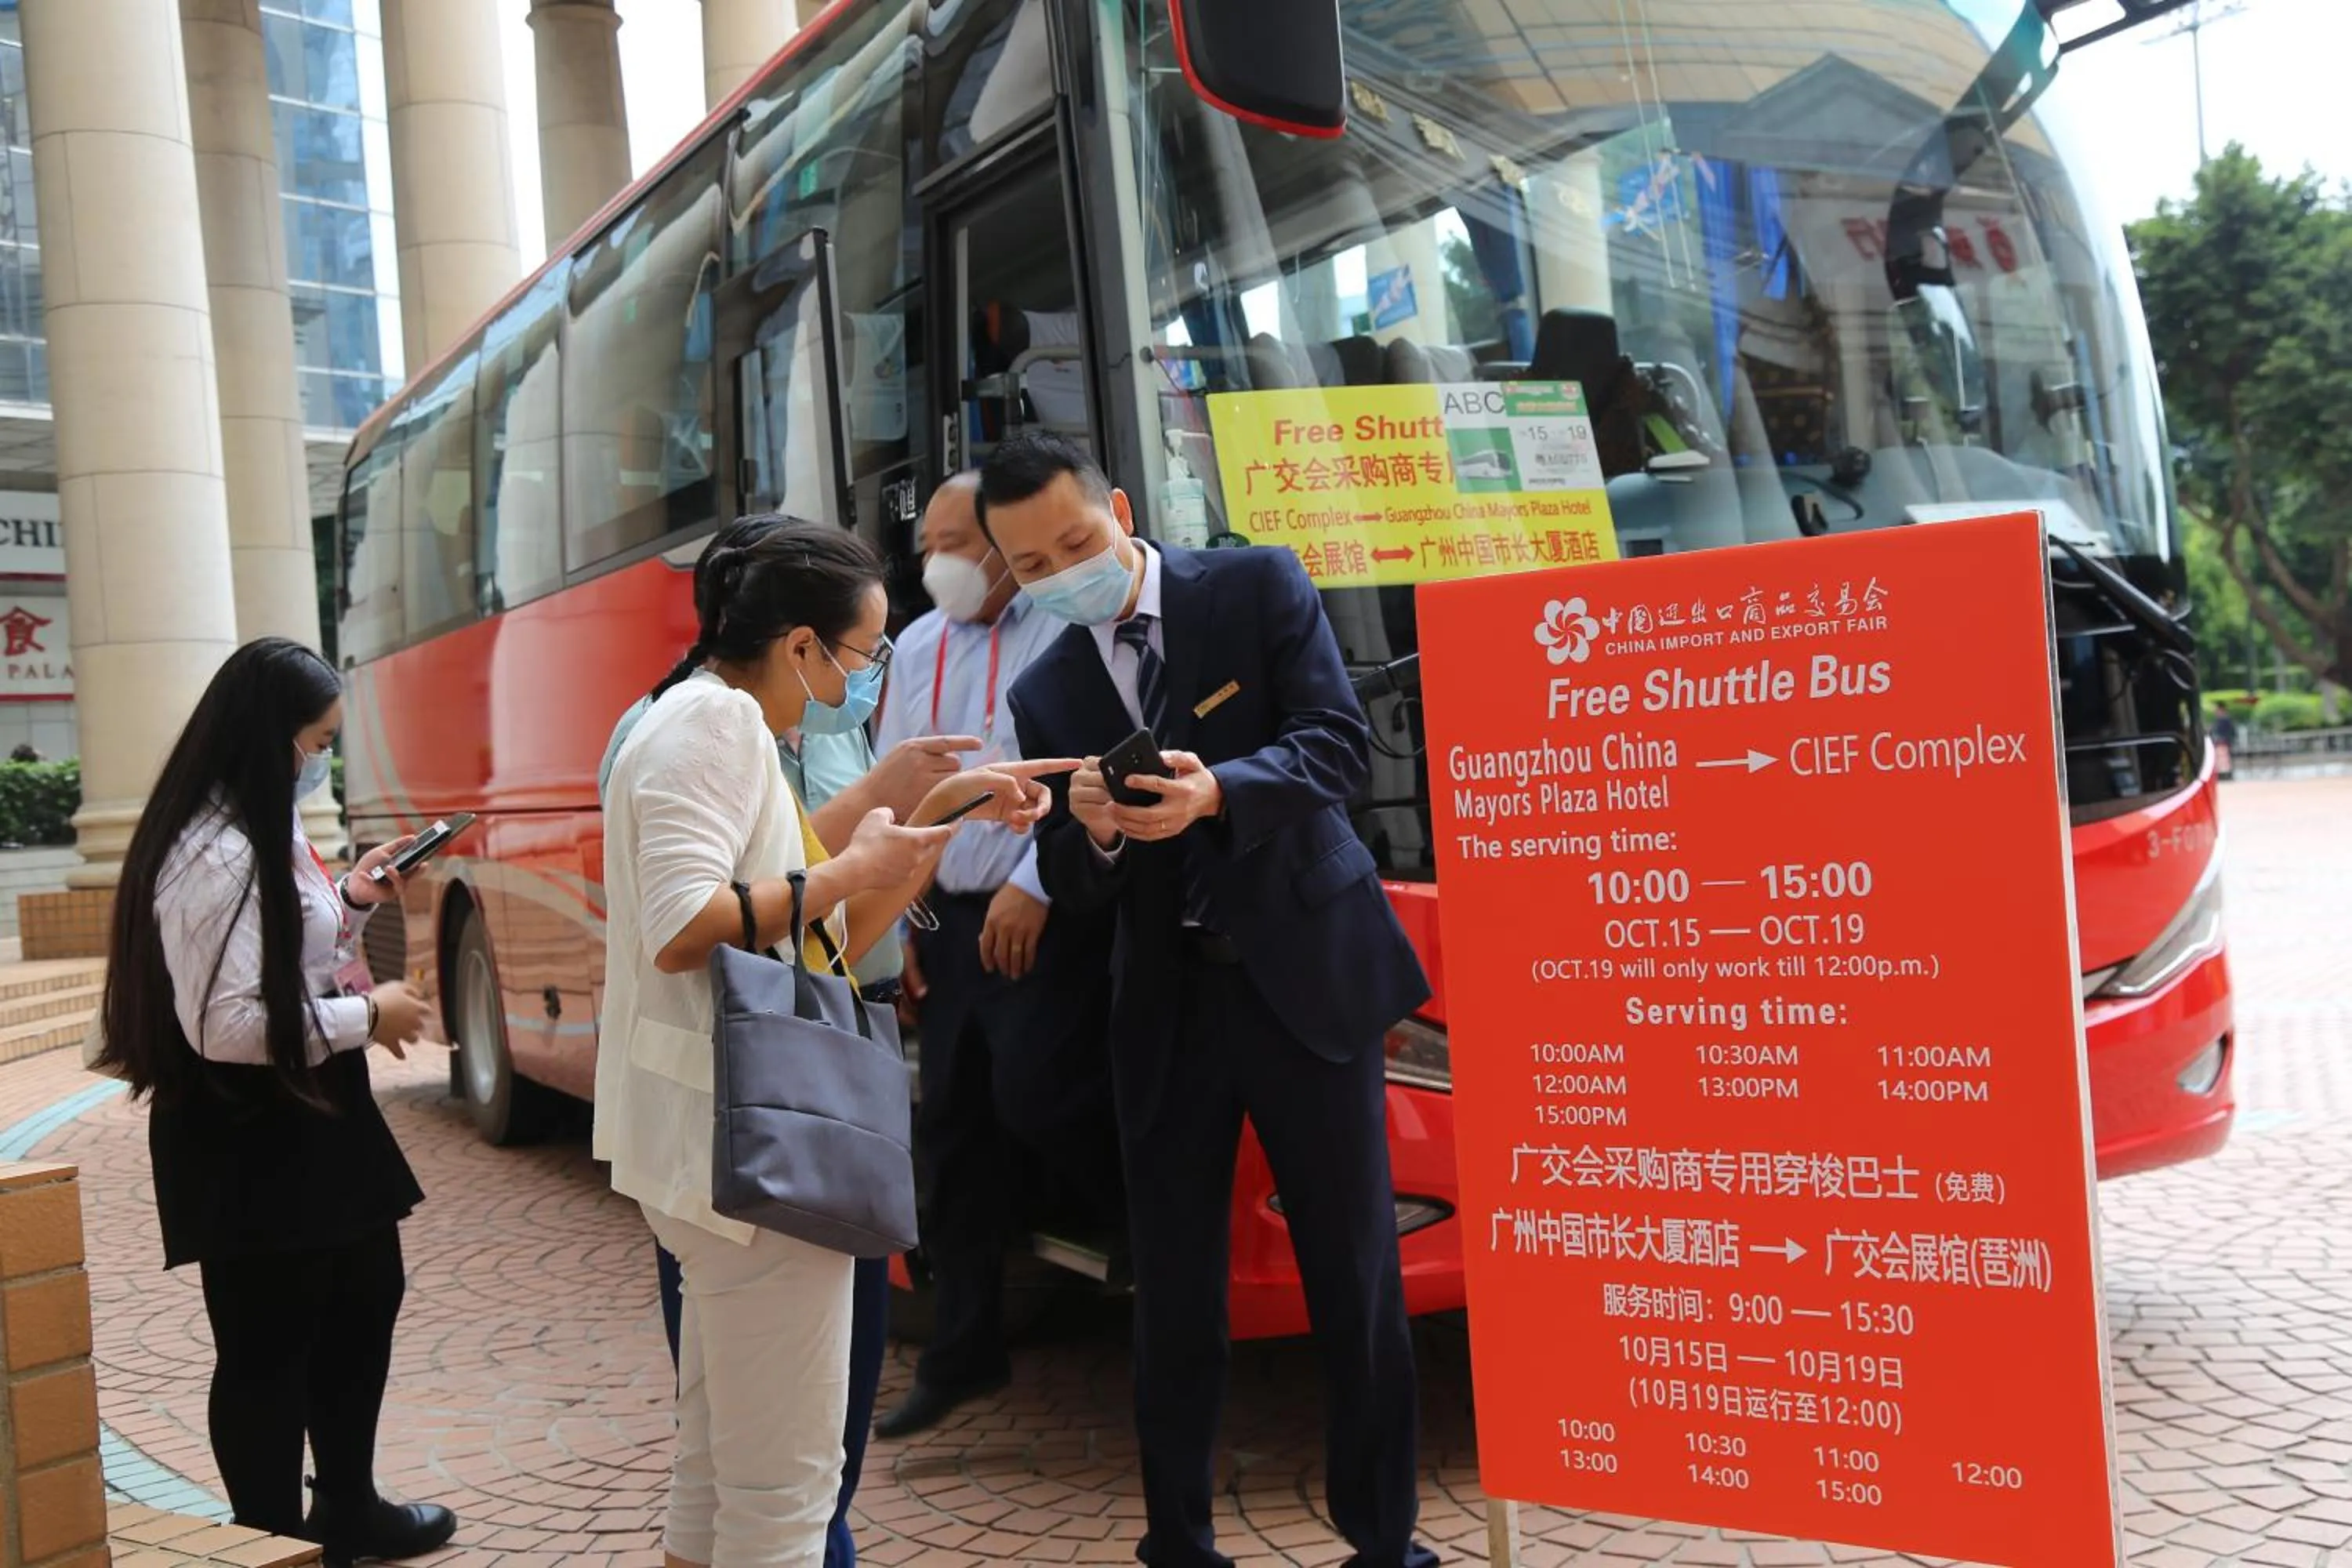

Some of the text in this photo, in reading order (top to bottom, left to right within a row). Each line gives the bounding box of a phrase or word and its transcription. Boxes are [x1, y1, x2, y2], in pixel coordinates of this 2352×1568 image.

[1443, 390, 1504, 414] ABC
[1274, 418, 1344, 445] Free
[1245, 451, 1454, 495] 广交会采购商专
[1249, 499, 1592, 533] CIEF Complex Guangzhou China Mayors Plaza Hotel
[1287, 529, 1601, 577] 会展馆 广州中国市长大厦酒店
[1605, 615, 1888, 656] CHINA IMPORT AND EXPORT FAIR
[1548, 654, 1891, 720] Free Shuttle Bus
[1449, 724, 2027, 788] Guangzhou China CIEF Complex
[1454, 774, 1669, 826] Mayors Plaza Hotel
[1457, 827, 1678, 861] The serving time:
[1588, 867, 1690, 905] 10:00
[1760, 861, 1872, 899] 15:00
[1605, 918, 1700, 949] OCT.15
[1760, 913, 1864, 946] OCT.19
[1531, 957, 1613, 982] (OCT.19
[1620, 956, 1655, 979] will
[1663, 956, 1708, 983] only
[1715, 956, 1770, 978] work
[1776, 955, 1806, 978] till
[1626, 996, 1848, 1031] Serving time:
[1530, 1044, 1991, 1068] 10:00AM 10:30AM 11:00AM
[1533, 1074, 1989, 1102] 12:00AM 13:00PM 14:00PM
[1534, 1105, 1627, 1127] 15:00PM
[1511, 1142, 1920, 1200] 广交会采购商专用穿梭巴士
[1490, 1207, 1740, 1269] 广州中国市长大厦酒店
[1729, 1292, 1783, 1326] 9:00
[1840, 1300, 1915, 1336] 15:30
[1619, 1335, 1728, 1374] 10月15日
[1784, 1348, 1904, 1389] 10月19日
[1558, 1417, 2024, 1490] 10:00 10:30 11:00 12:00
[1560, 1449, 1883, 1507] 13:00 14:00 15:00
